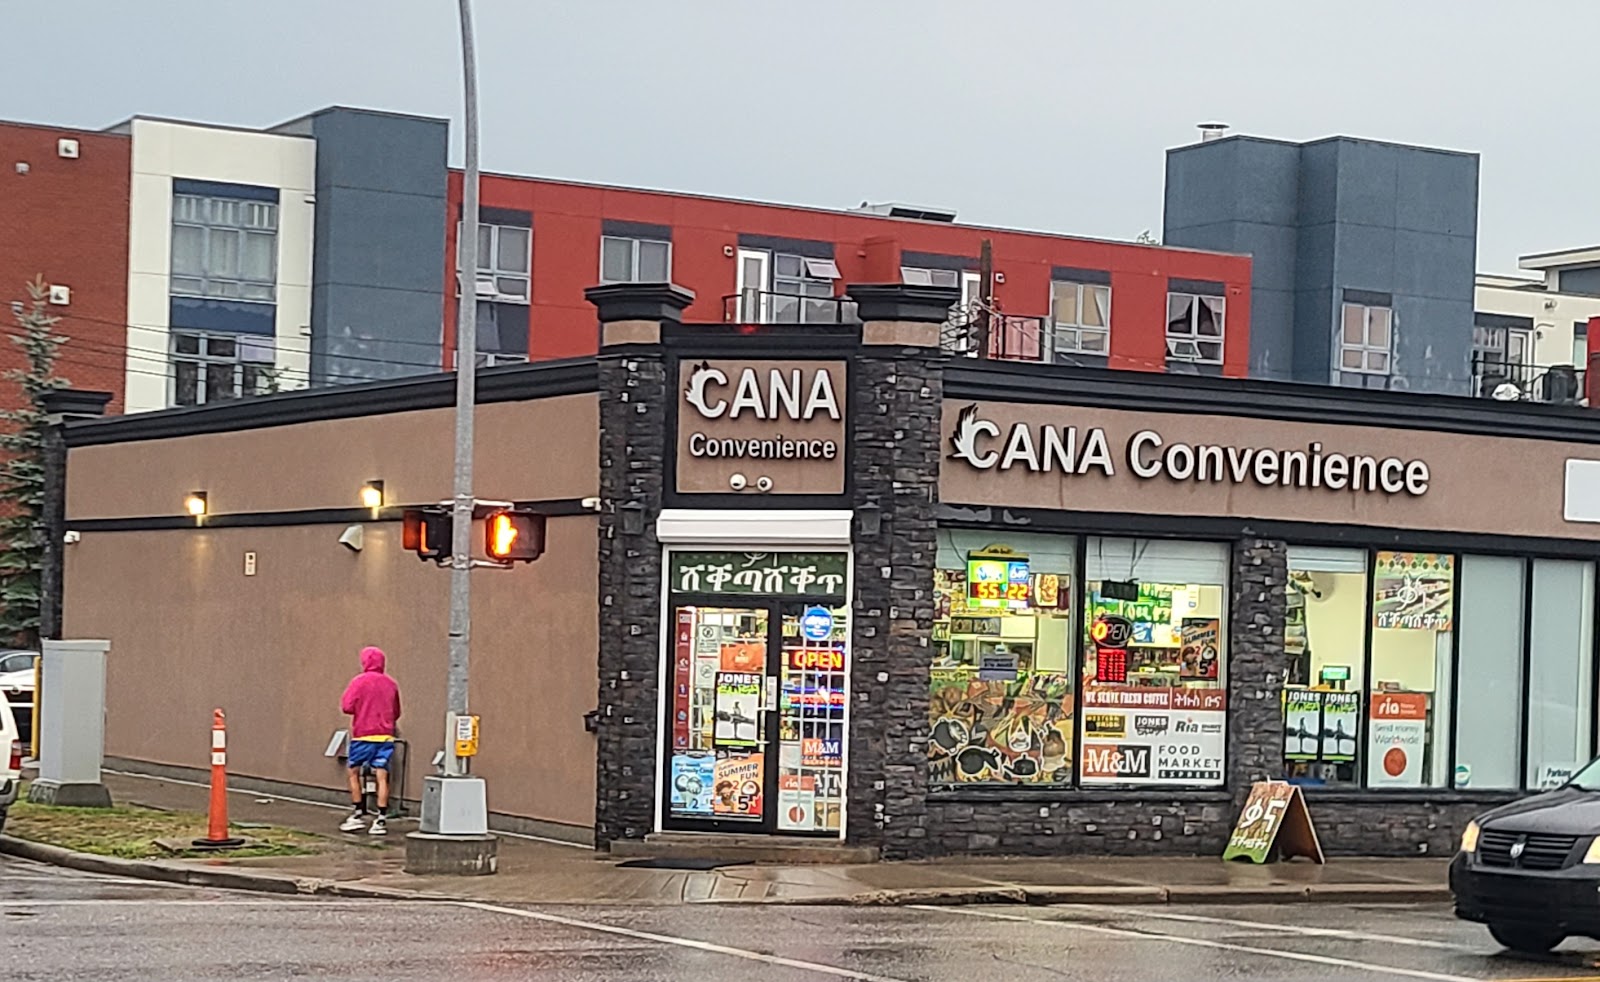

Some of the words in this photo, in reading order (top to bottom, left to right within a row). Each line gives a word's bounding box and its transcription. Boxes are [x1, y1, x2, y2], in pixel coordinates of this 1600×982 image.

[685, 364, 841, 420] CANA
[689, 432, 836, 459] Convenience
[955, 408, 1115, 477] CANA
[1130, 430, 1430, 499] Convenience
[978, 582, 999, 599] 55
[1007, 583, 1028, 600] 22
[1091, 622, 1131, 640] OPEN
[794, 650, 843, 669] OPEN
[1199, 660, 1208, 675] 5
[717, 672, 761, 685] JONES
[1287, 691, 1321, 702] JONES
[1325, 693, 1358, 704] JONES
[1378, 697, 1400, 715] ria
[1136, 716, 1167, 726] JONES
[1175, 716, 1198, 733] Ria
[804, 741, 839, 754] M&M
[1158, 745, 1200, 755] FOOD
[1086, 748, 1148, 774] M&M
[1158, 758, 1222, 769] MARKET
[718, 763, 759, 780] SUMMER
[740, 772, 759, 781] FUN
[1160, 770, 1218, 779] EXPRESS
[738, 795, 749, 811] 5
